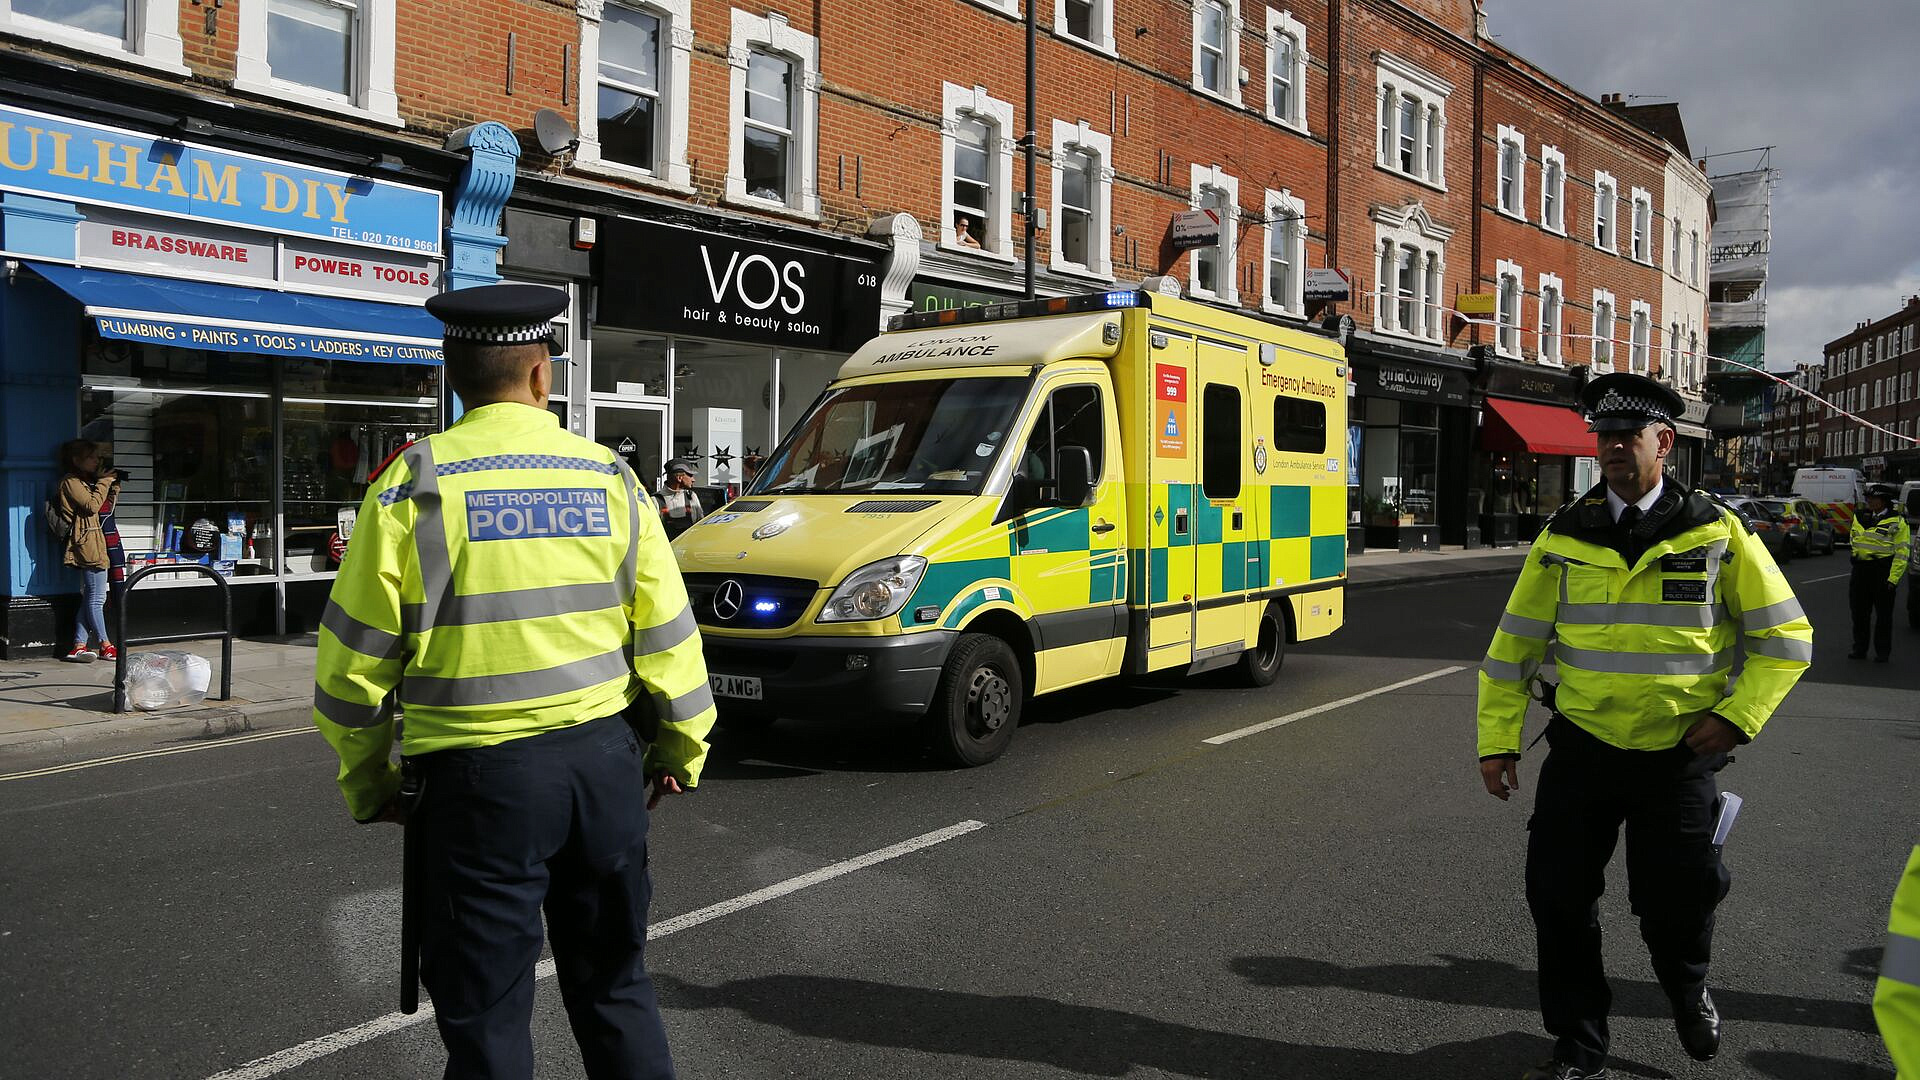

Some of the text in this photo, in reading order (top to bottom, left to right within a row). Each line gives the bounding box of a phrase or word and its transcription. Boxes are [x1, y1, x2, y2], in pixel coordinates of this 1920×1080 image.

[261, 171, 357, 224] DIY
[112, 229, 248, 263] BRASSWARE
[331, 226, 439, 252] TEL: 020 7610 9661
[295, 256, 430, 286] POWER TOOLS
[701, 245, 805, 315] VOS
[858, 273, 876, 287] 618
[683, 306, 820, 335] hair & beauty salon
[100, 320, 444, 362] PLUMBING PAINTS TOOLS LADDERS KEY CUTTING
[907, 335, 993, 348] LONDON
[872, 345, 999, 365] AMBULANCE
[1166, 386, 1177, 397] 999
[1262, 368, 1336, 398] Emergency Ambulance
[1167, 424, 1177, 434] 111
[468, 491, 605, 507] METROPOLITAN
[470, 507, 609, 537] POLICE
[711, 675, 753, 696] 12 AWG
